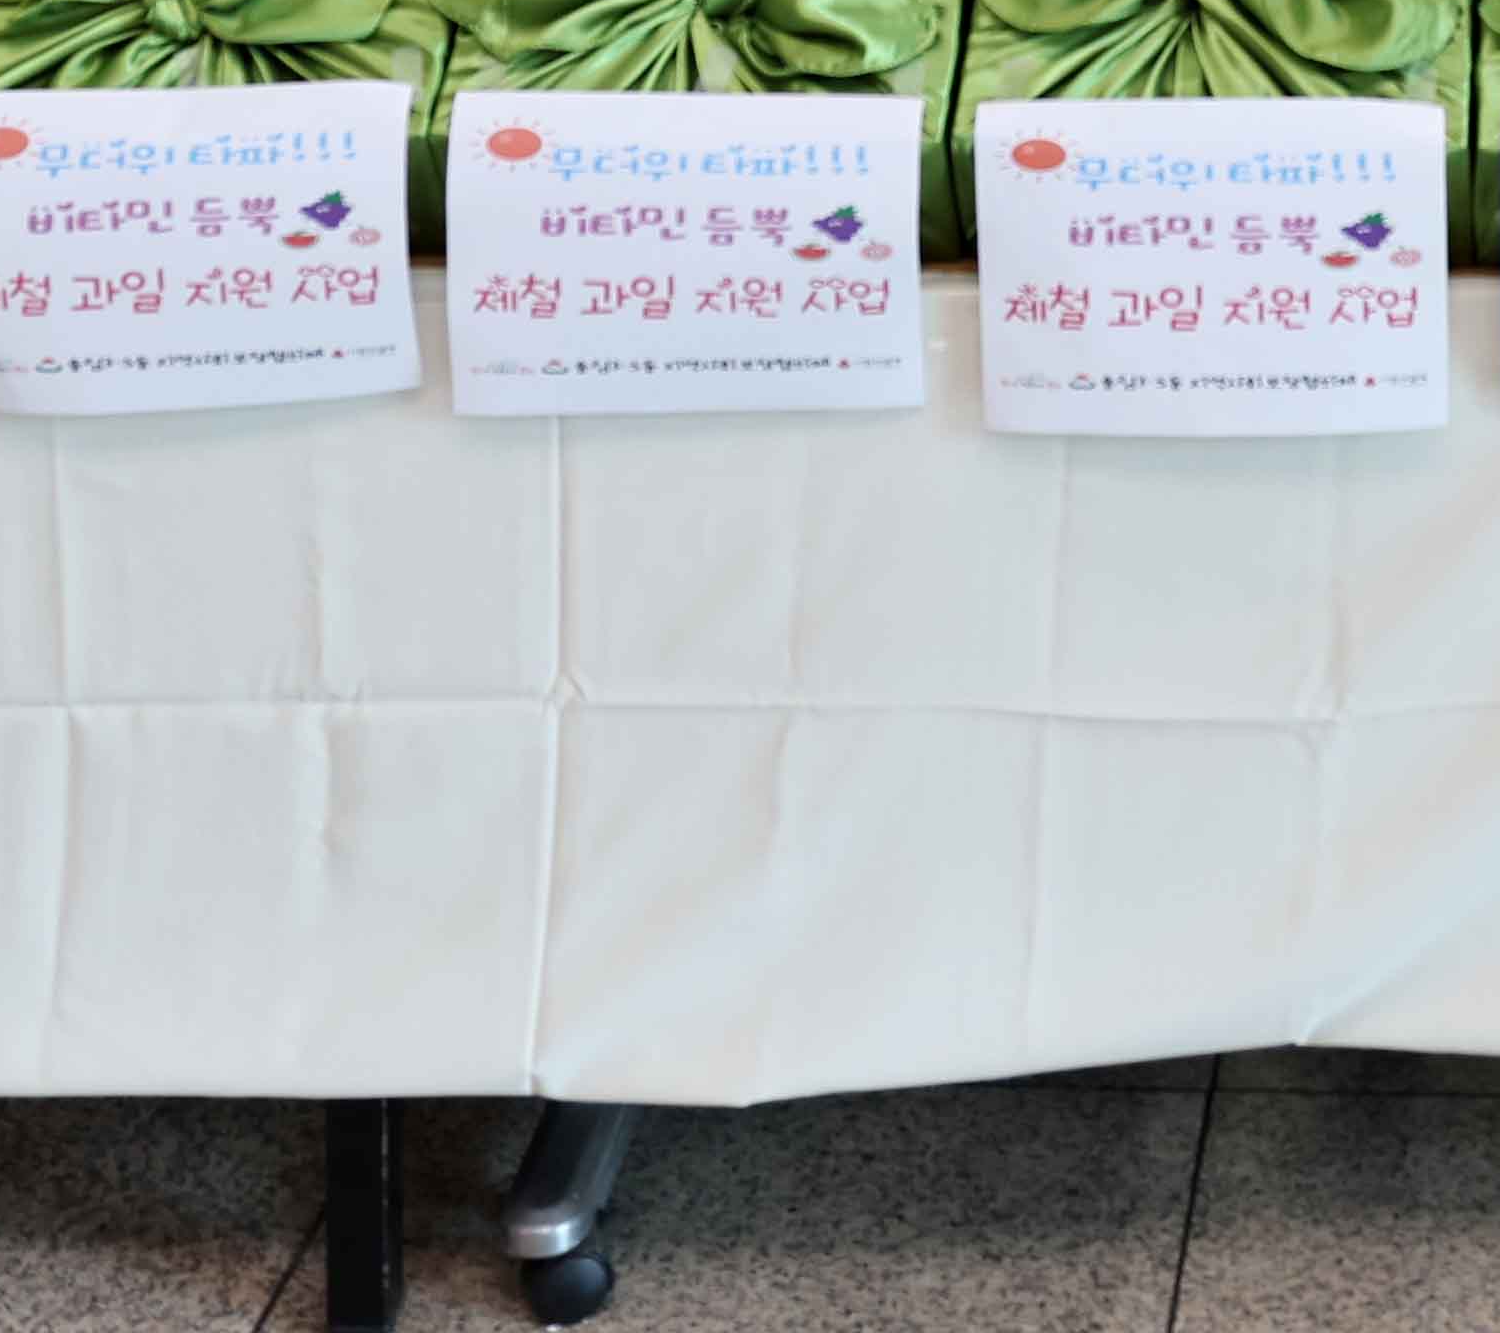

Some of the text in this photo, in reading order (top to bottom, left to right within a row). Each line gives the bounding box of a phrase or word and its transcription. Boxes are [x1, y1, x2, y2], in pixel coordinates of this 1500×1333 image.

[38, 130, 359, 179] 무더위 타파!!!
[551, 146, 867, 182] 무더위 타파!!!
[1077, 151, 1395, 191] 무더위 타파!!!
[28, 199, 174, 233] 비타민
[538, 204, 688, 242] 비타민
[1068, 214, 1215, 249] 비타민
[72, 269, 167, 316] 과일
[187, 266, 276, 305] 지원
[293, 266, 382, 306] 사업
[476, 274, 894, 320] 제철 과일 지원 사업
[1003, 283, 1422, 332] 제철 과일 지원 사업
